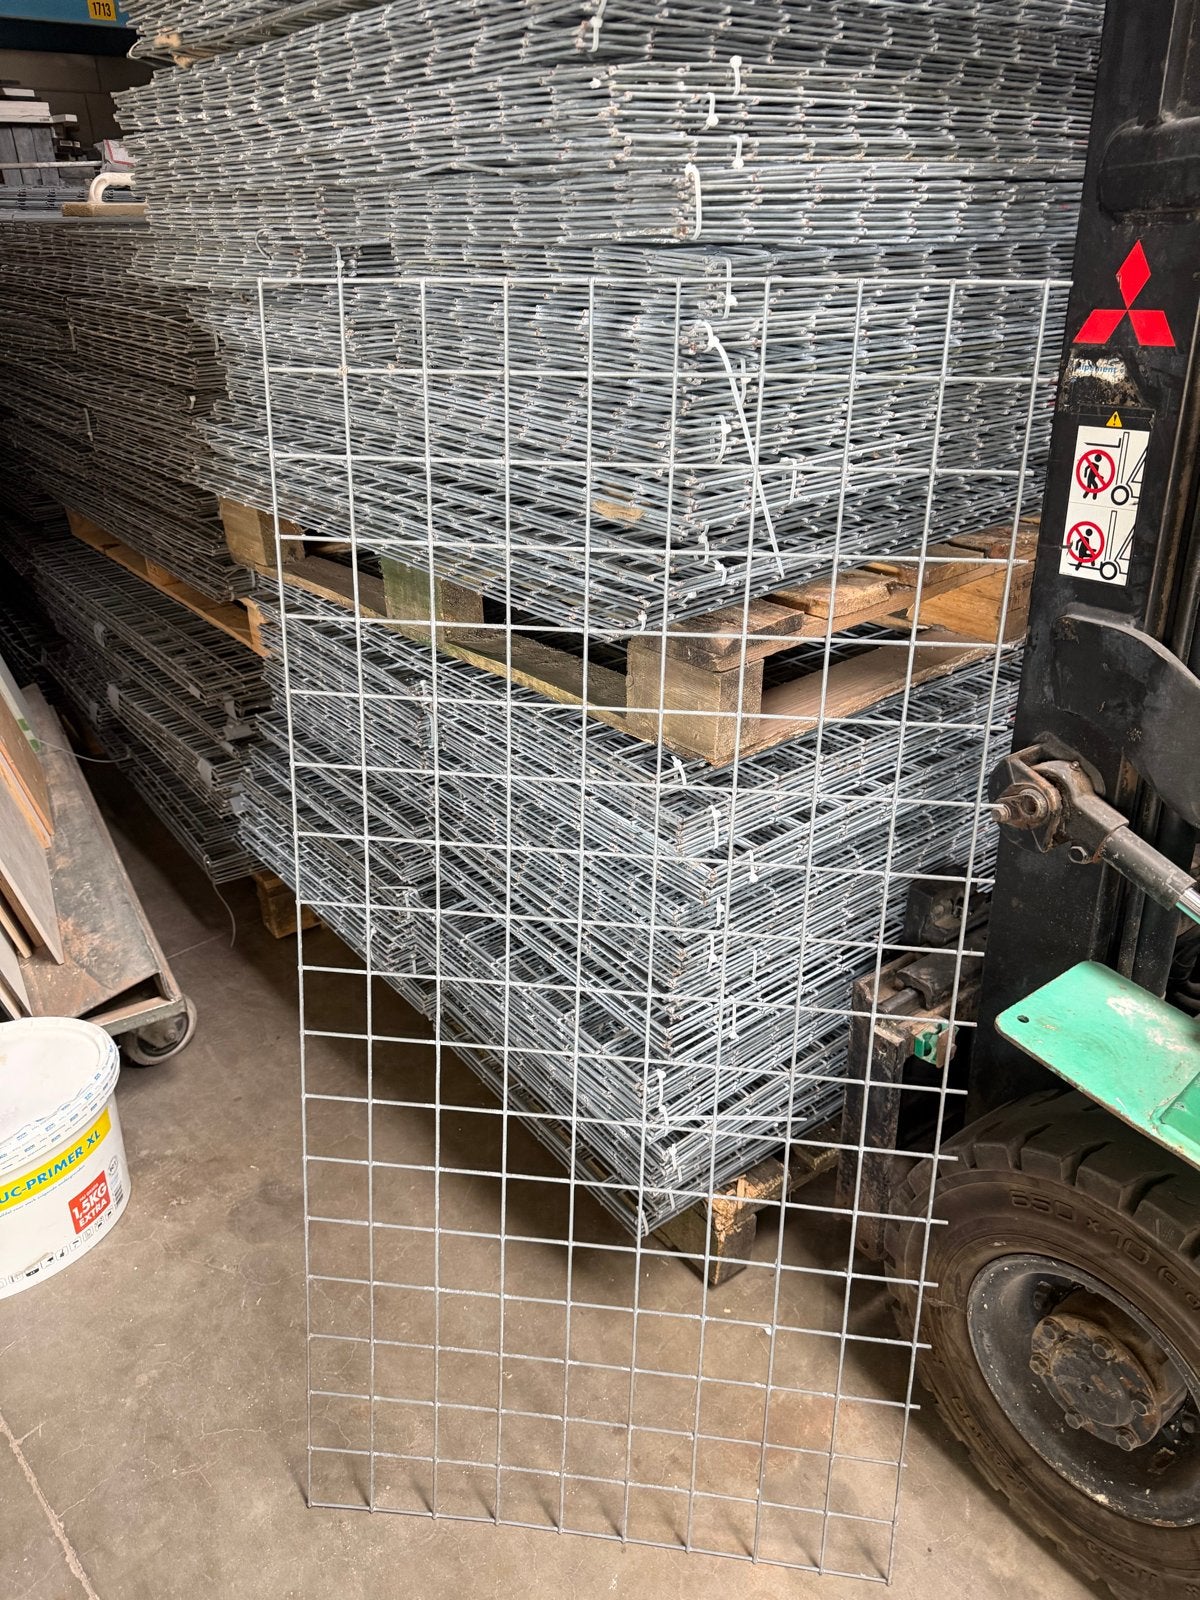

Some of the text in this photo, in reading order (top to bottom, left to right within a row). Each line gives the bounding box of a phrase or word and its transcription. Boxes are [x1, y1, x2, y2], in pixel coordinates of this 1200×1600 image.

[92, 2, 111, 16] 1713
[86, 1130, 100, 1149] XL
[72, 1182, 107, 1220] 1,5KG
[79, 1199, 107, 1227] EXTRA
